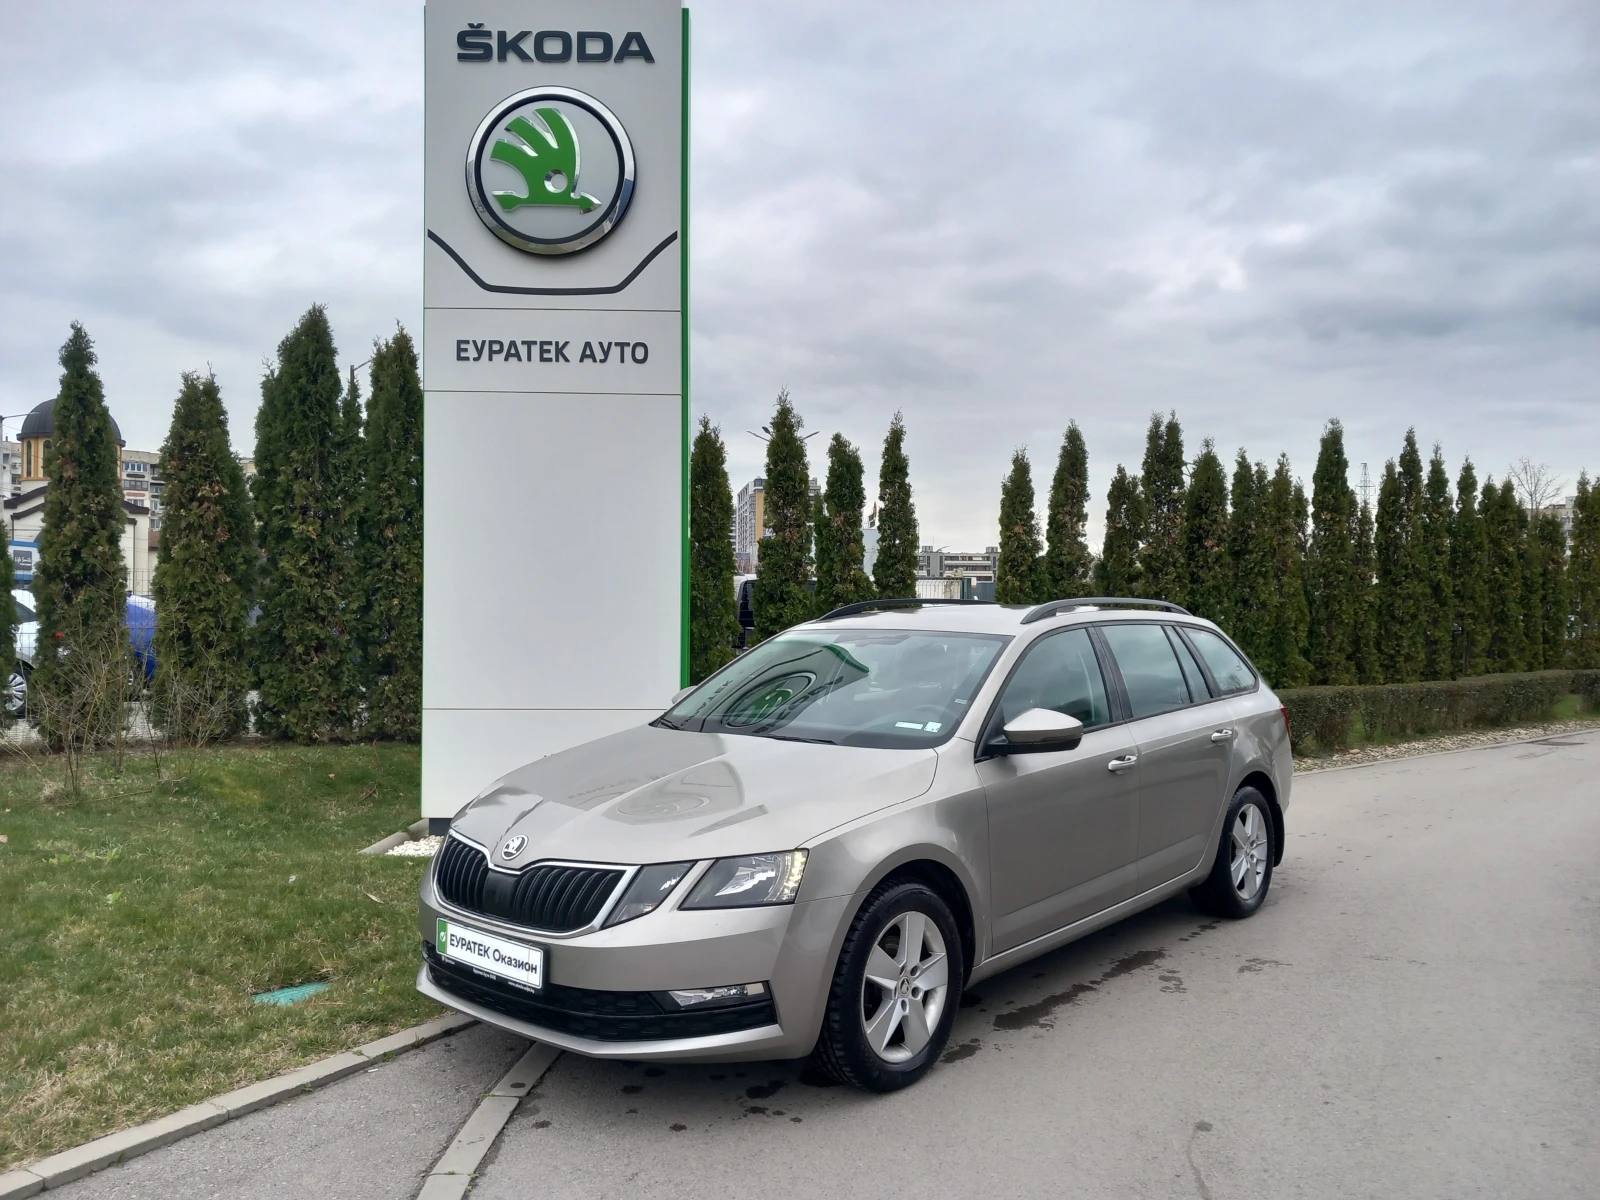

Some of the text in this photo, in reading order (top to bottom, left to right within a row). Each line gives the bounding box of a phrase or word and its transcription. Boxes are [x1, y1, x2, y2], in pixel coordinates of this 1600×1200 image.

[457, 23, 655, 63] ŠKODA
[456, 340, 649, 364] ЕУРАТЕК АУТО
[449, 934, 538, 975] ЕУРАТЕК Оказион
